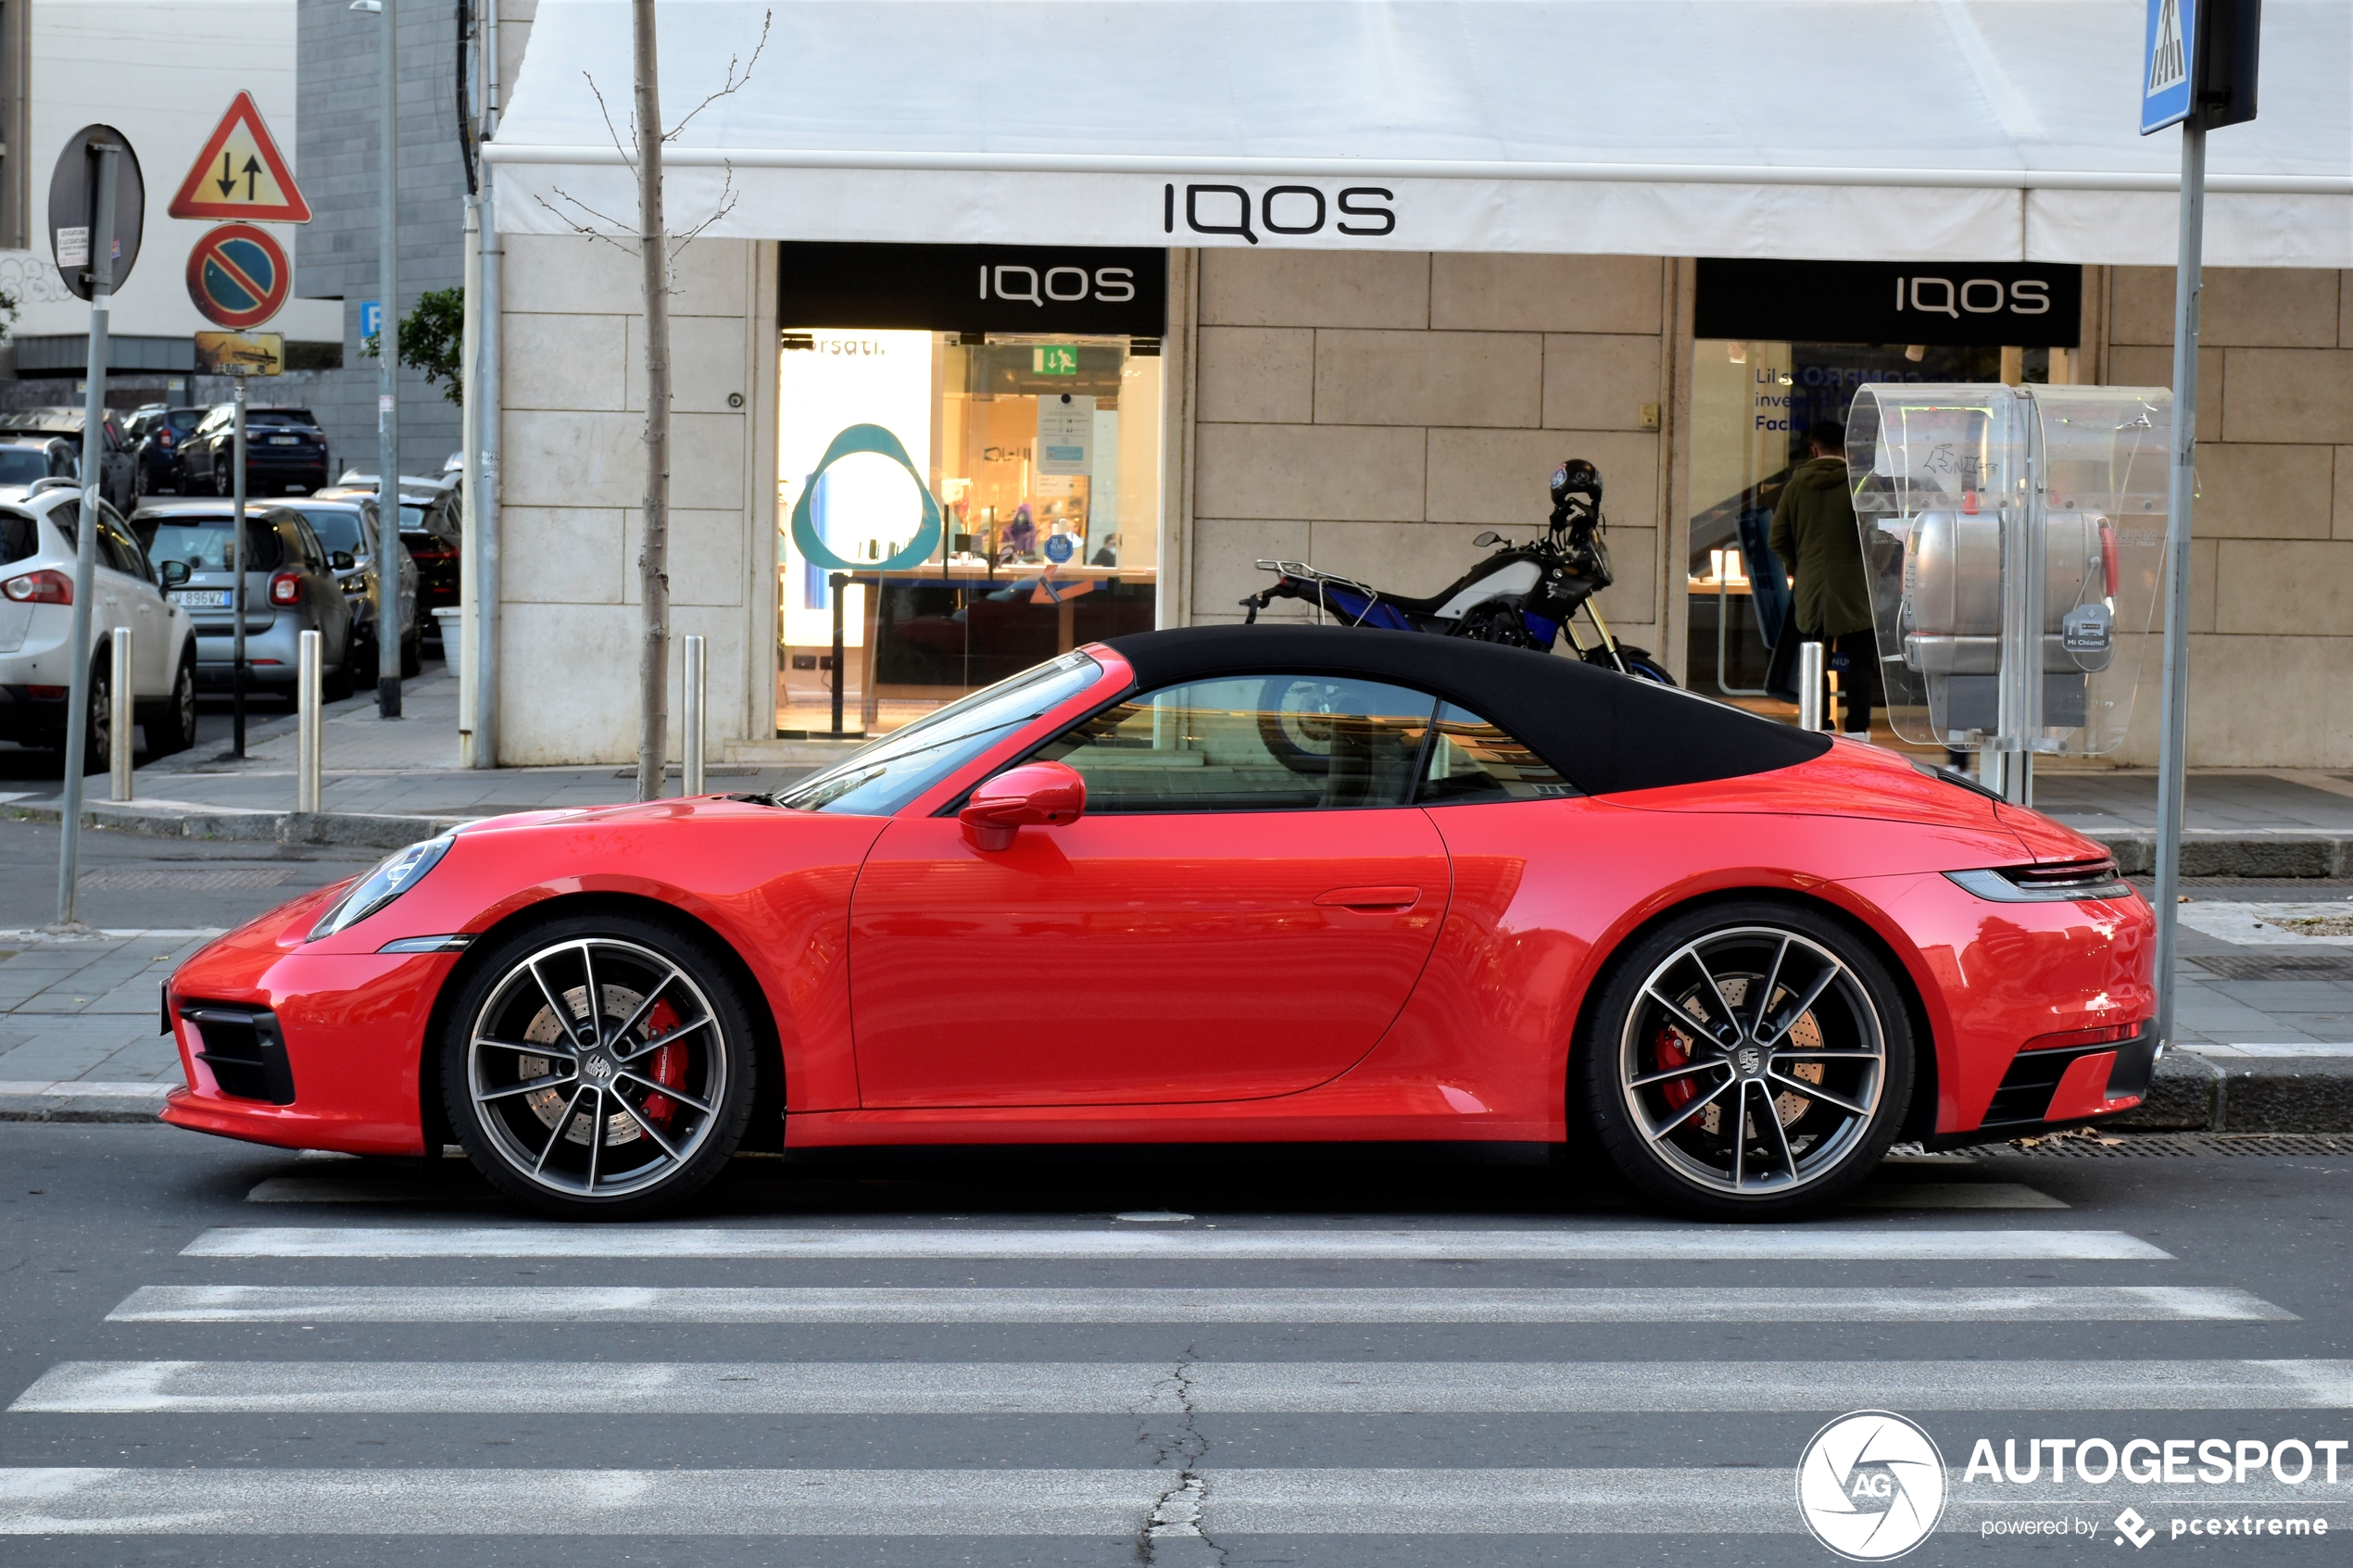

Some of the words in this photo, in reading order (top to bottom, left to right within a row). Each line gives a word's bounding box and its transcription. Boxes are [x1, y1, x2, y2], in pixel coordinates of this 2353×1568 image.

[1164, 183, 1396, 245] IQOS
[979, 265, 1136, 307] IQOS
[1895, 277, 2051, 319] IQOS
[1756, 369, 1776, 384] Lil
[185, 592, 223, 605] 896WZ
[658, 1046, 669, 1099] PORSCE
